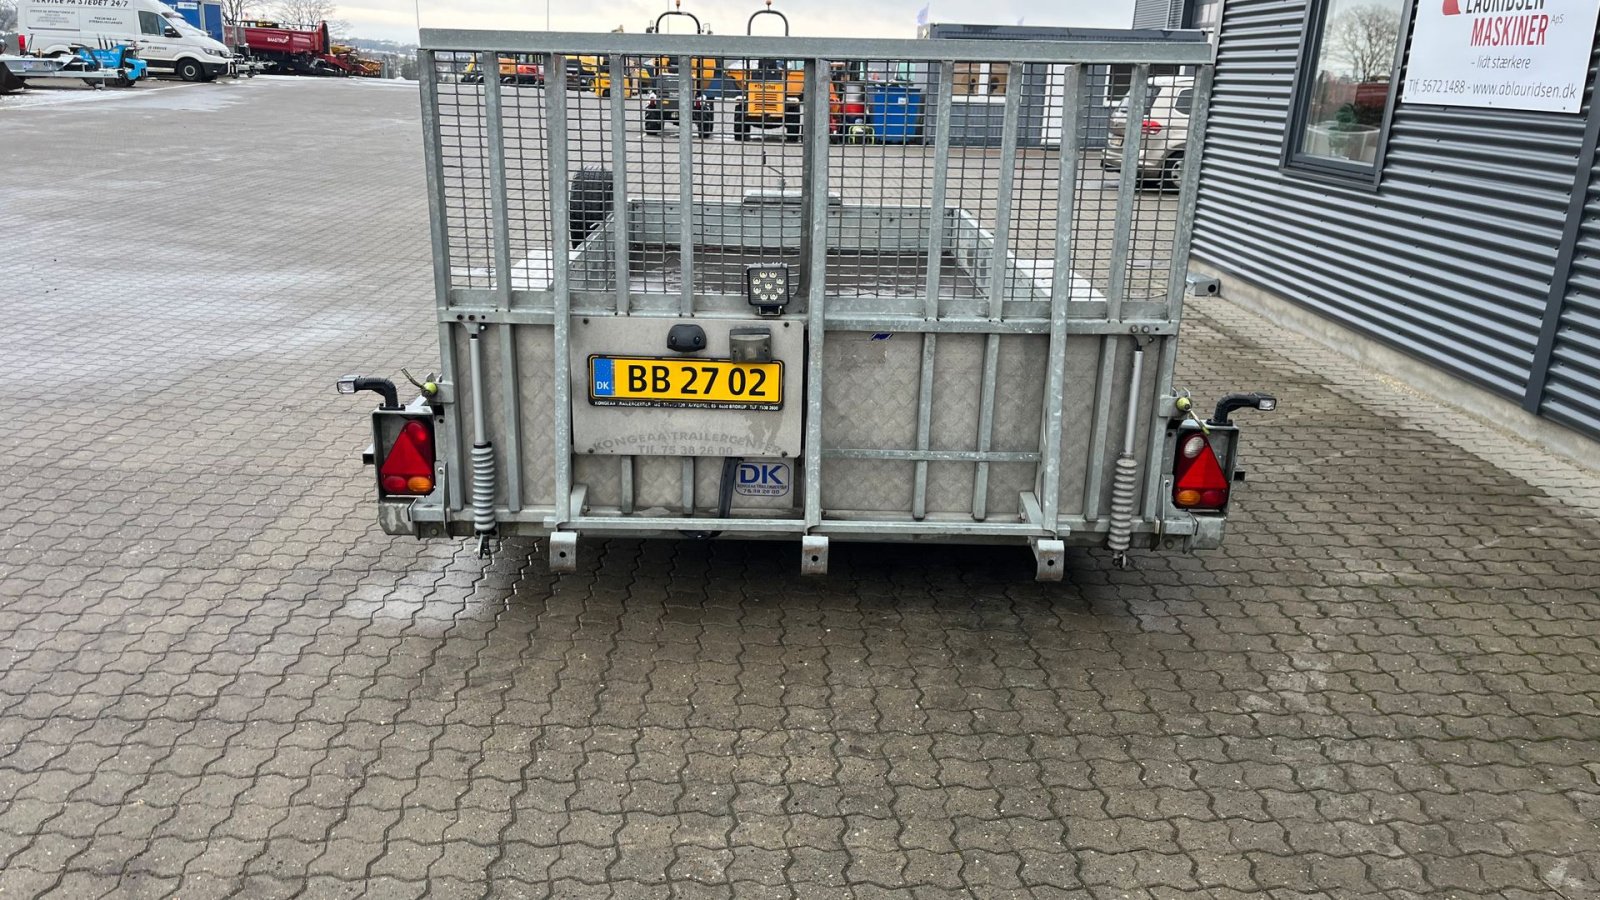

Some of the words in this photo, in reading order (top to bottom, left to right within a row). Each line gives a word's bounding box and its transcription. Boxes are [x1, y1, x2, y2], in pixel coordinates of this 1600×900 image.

[1551, 14, 1565, 26] ApS
[1470, 14, 1549, 46] MASKINER
[1477, 56, 1490, 69] lidt
[1492, 56, 1531, 69] stærkere
[1408, 78, 1420, 95] Tlf.
[1422, 79, 1442, 93] 5672
[1443, 79, 1466, 94] 1488
[1473, 81, 1577, 99] www.ablauridsen.dk
[596, 381, 609, 390] DK
[628, 365, 671, 393] BB
[680, 366, 719, 395] 27
[728, 367, 767, 396] 02
[680, 446, 695, 455] 38
[718, 447, 733, 456] 00
[740, 464, 784, 485] DK
